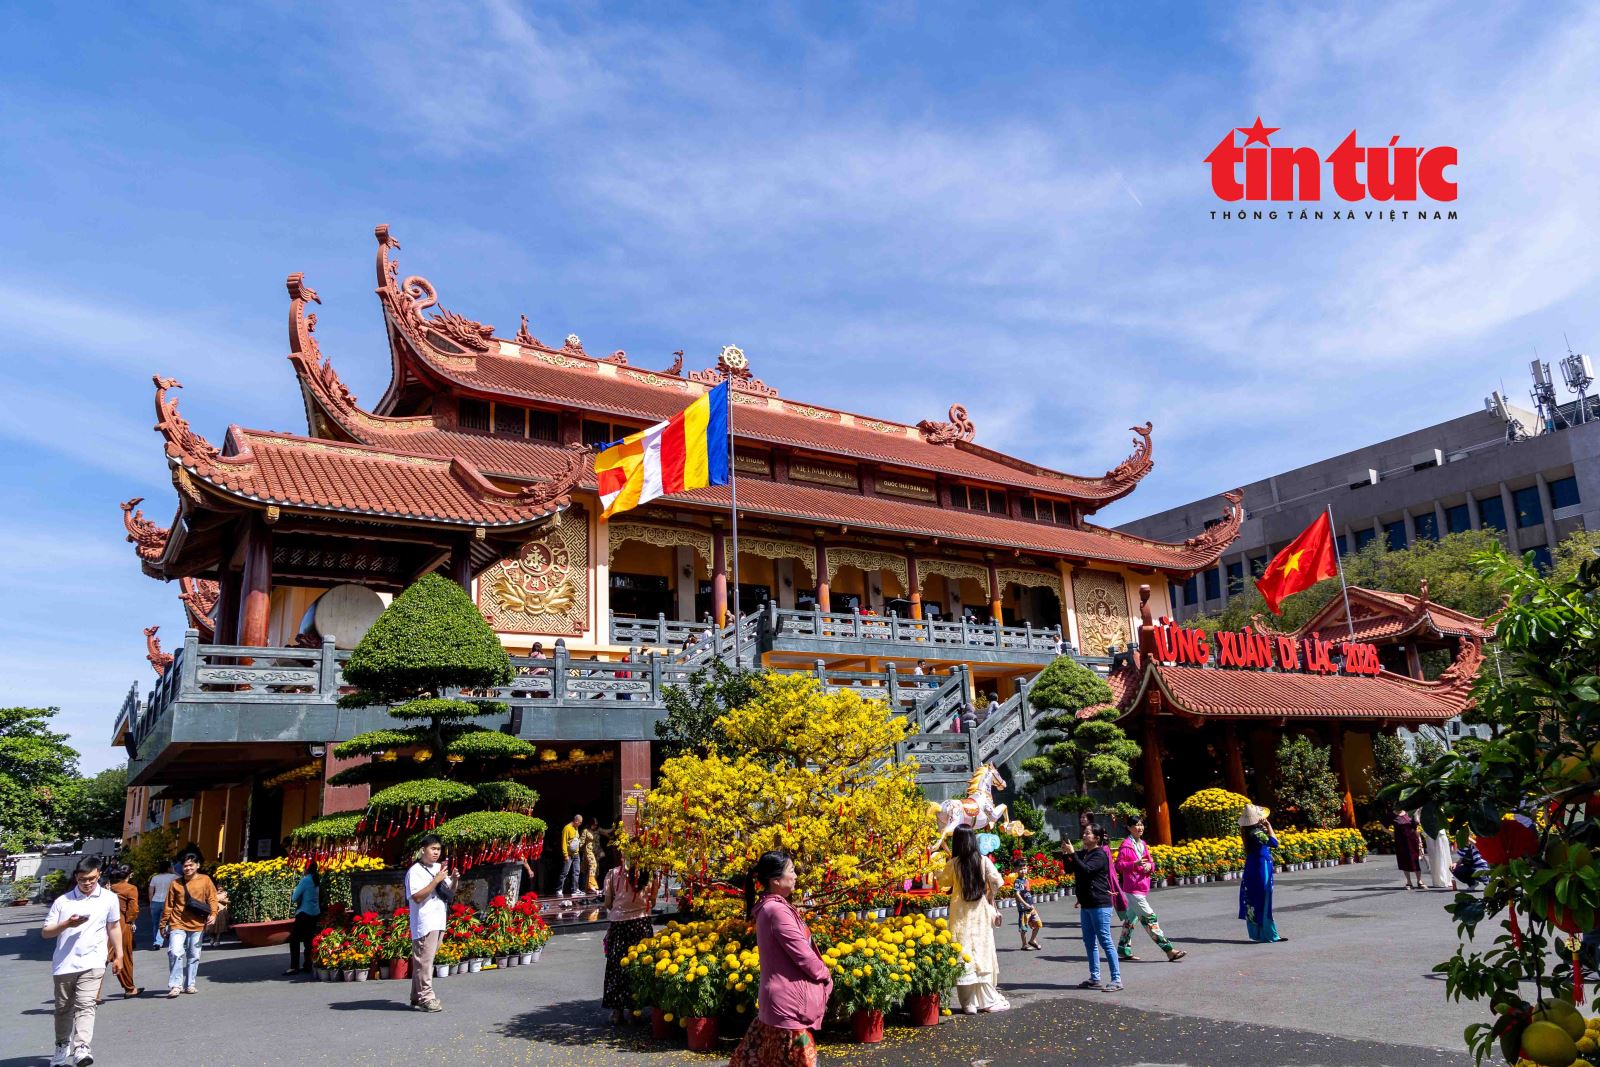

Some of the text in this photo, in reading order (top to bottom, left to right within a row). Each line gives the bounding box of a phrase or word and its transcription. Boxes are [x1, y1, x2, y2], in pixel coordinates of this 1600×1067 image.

[1216, 625, 1273, 668] XUÂN
[1277, 636, 1300, 670] DI
[1343, 641, 1380, 675] 2026
